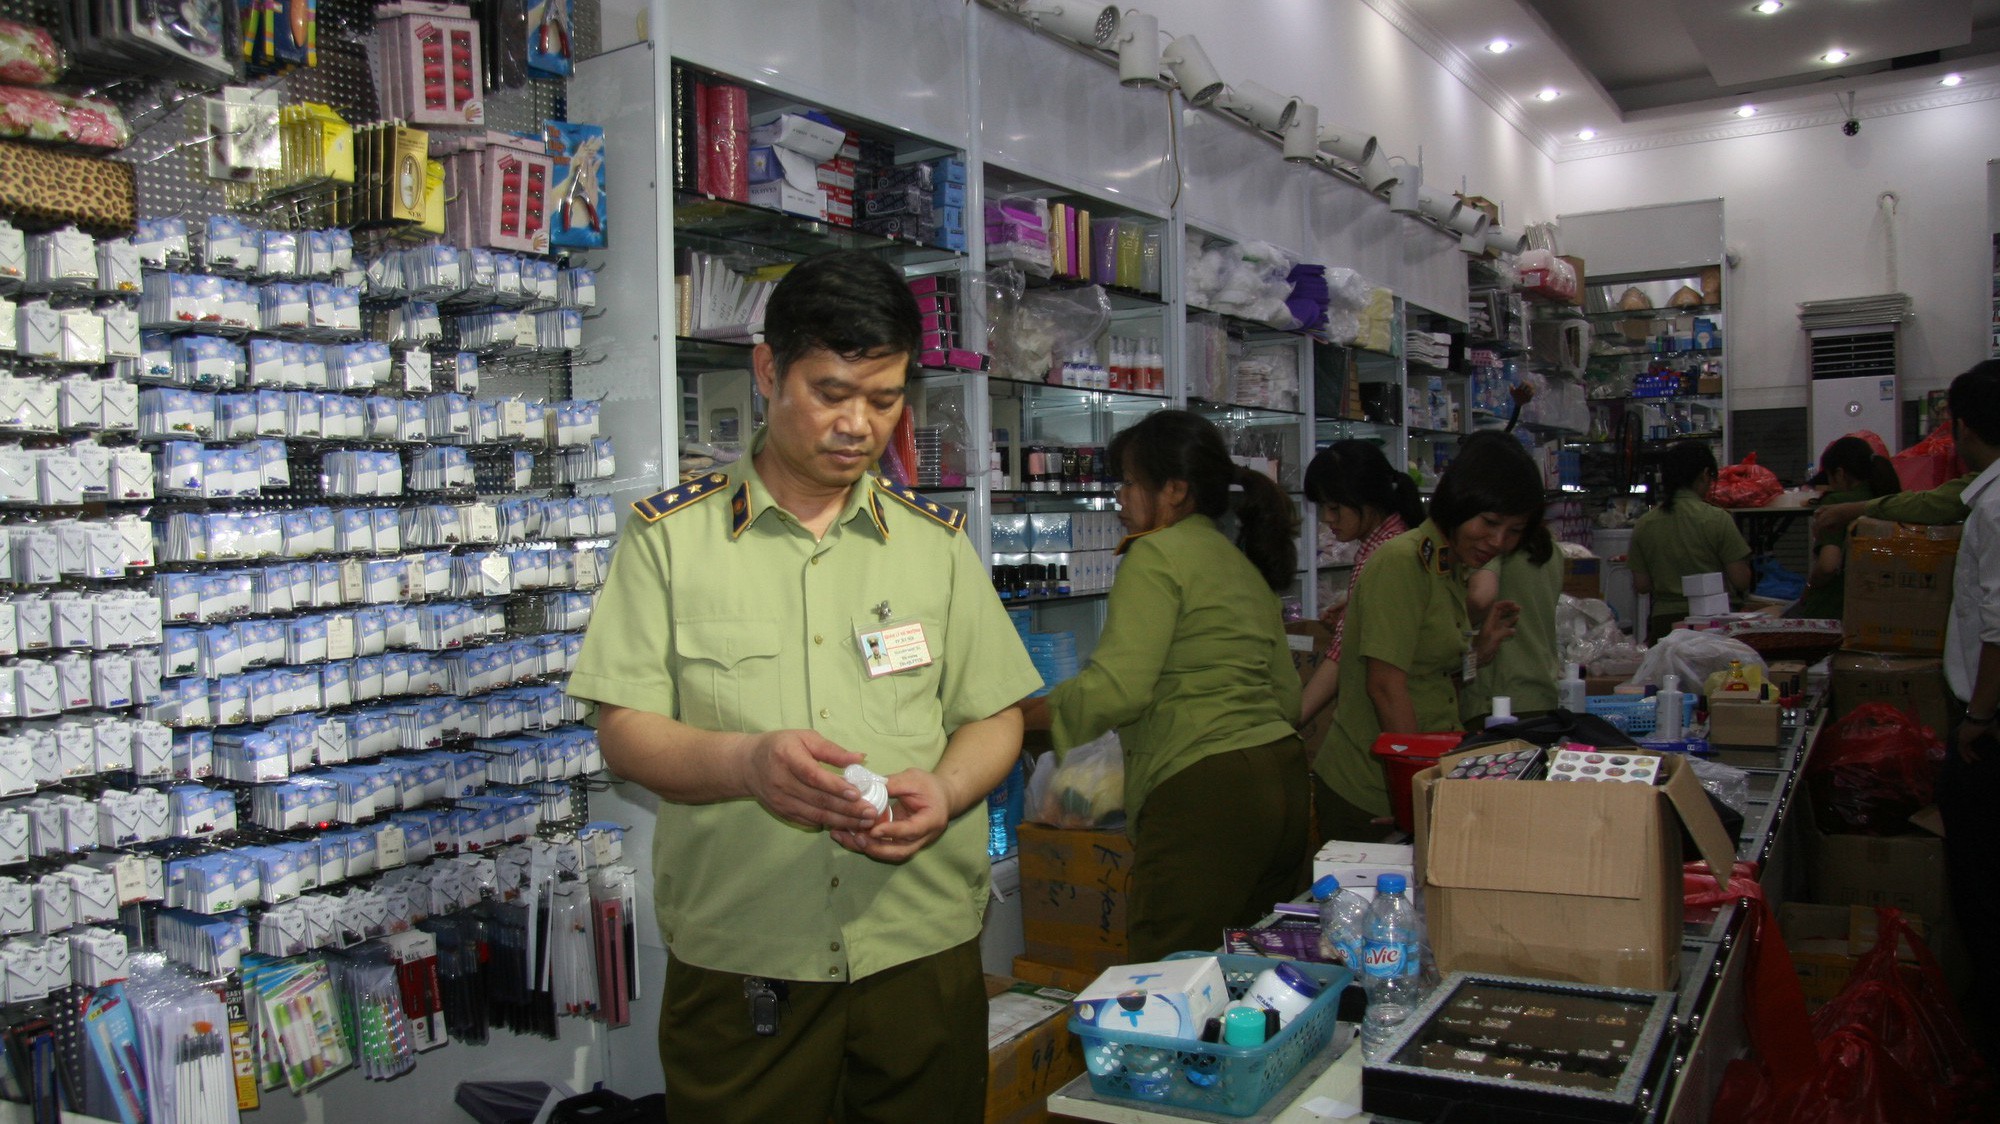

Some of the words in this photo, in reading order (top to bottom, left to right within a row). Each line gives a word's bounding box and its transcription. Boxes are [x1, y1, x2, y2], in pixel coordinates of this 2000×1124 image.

[225, 990, 242, 998] EASY
[226, 996, 243, 1004] GRIP
[227, 1005, 241, 1019] 12
